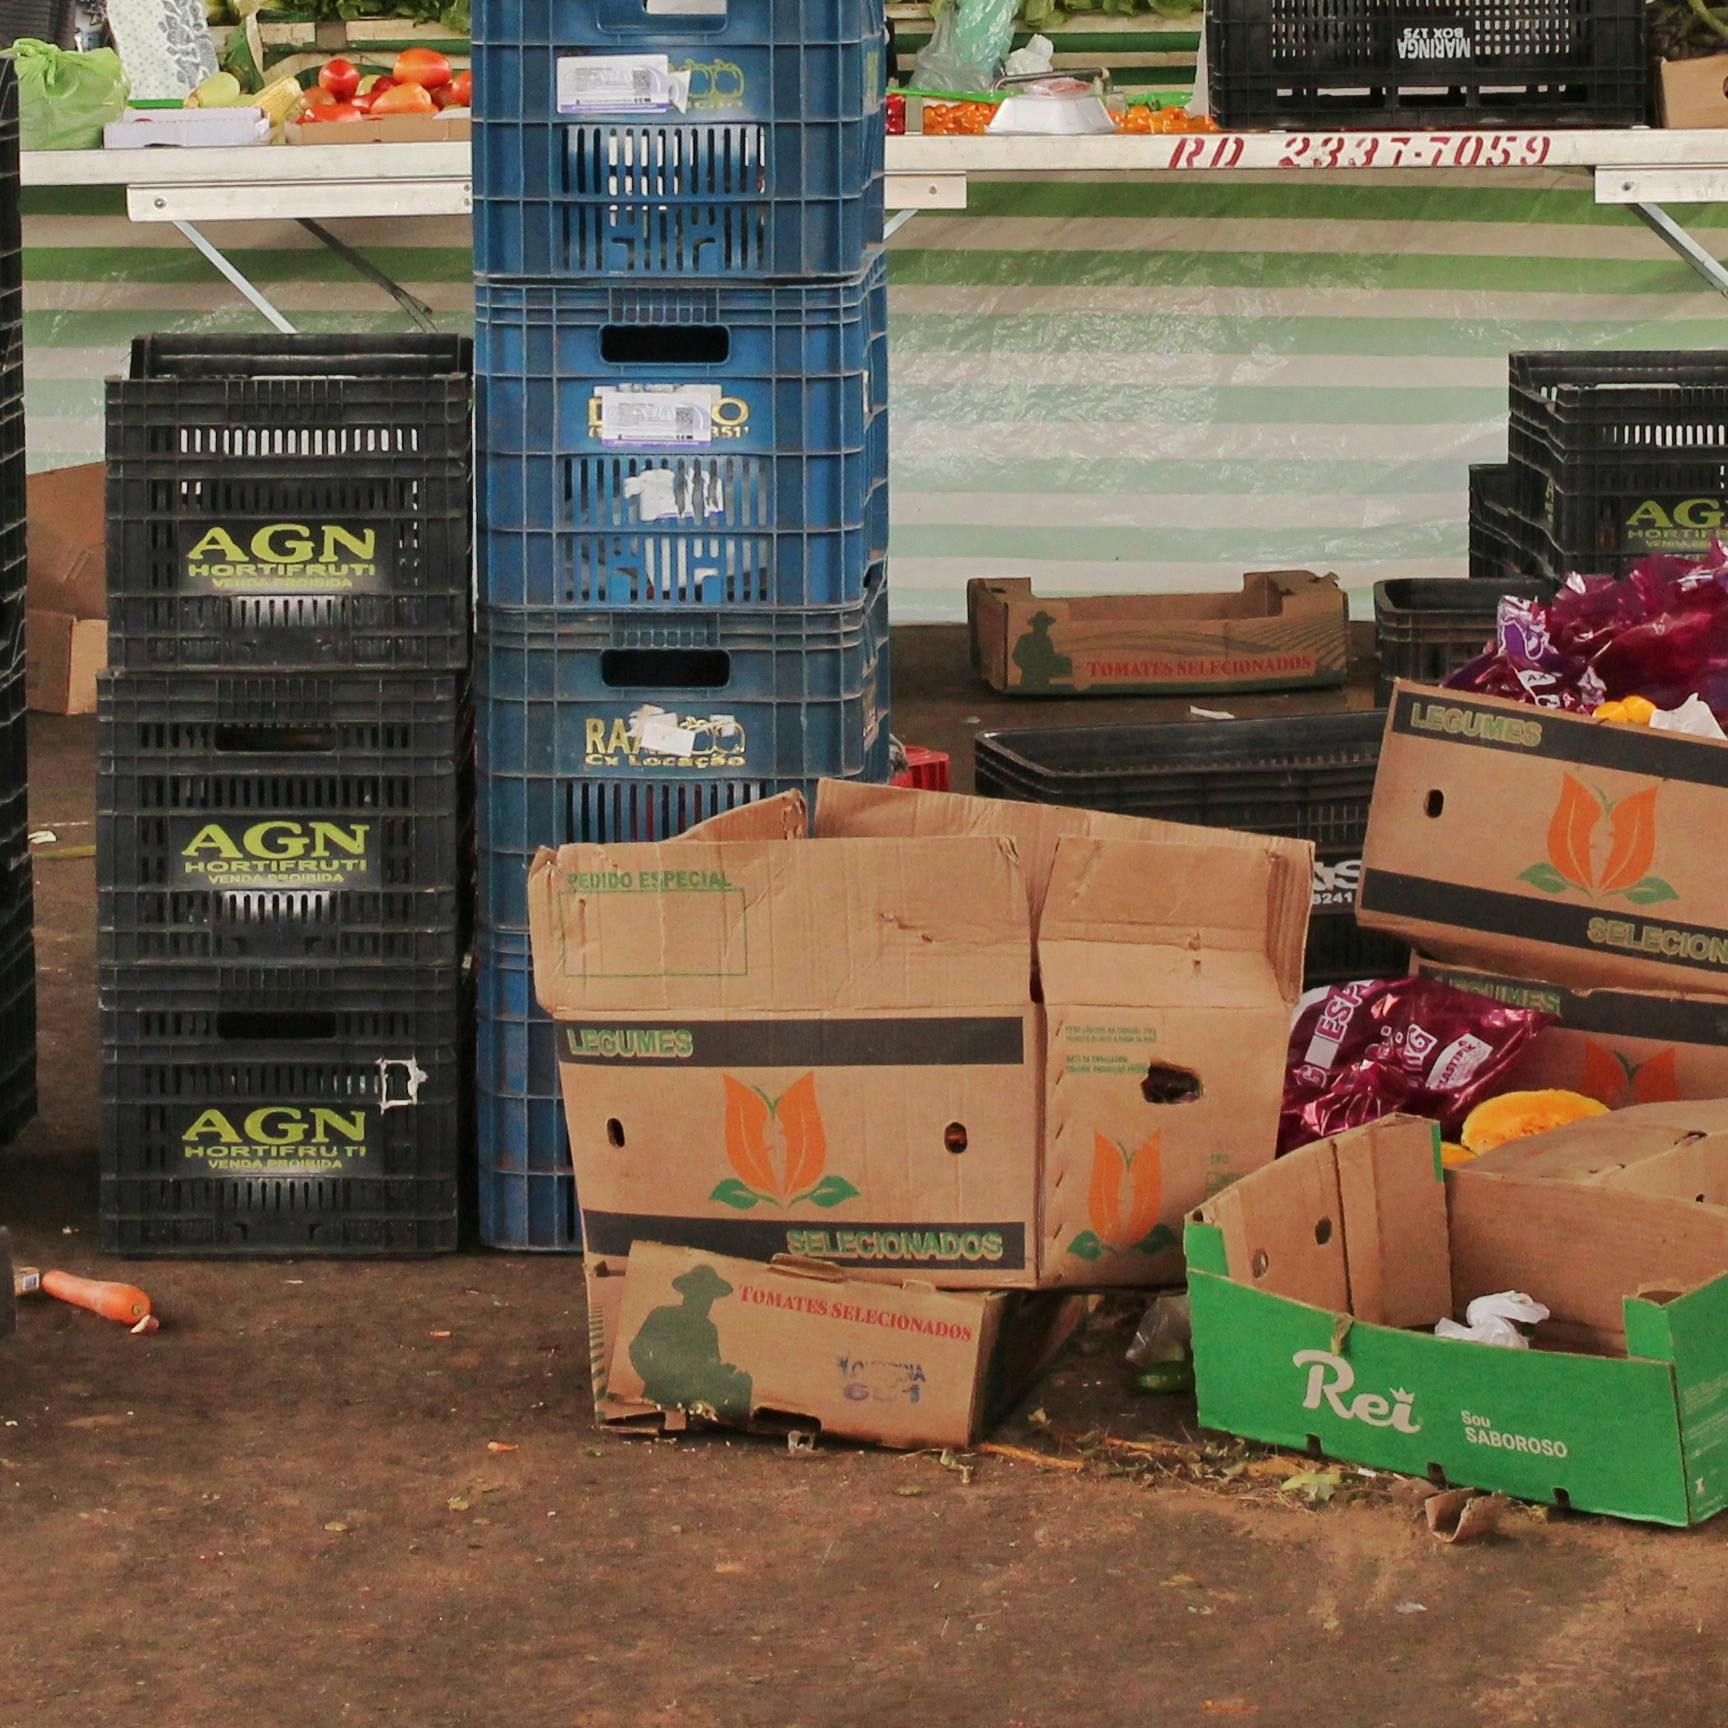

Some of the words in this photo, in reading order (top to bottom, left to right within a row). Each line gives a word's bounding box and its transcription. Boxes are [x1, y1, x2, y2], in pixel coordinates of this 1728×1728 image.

[186, 523, 376, 564] AGN
[188, 564, 377, 578] HORTIFRUTI
[1086, 660, 1174, 678] TOMATES
[1175, 654, 1313, 677] SELECIONADOS
[1410, 701, 1543, 748] LEGUMES
[181, 820, 371, 860] AGN
[184, 859, 369, 874] HORTIFRUTI
[565, 870, 634, 891] PEDIDO
[636, 869, 734, 891] ESPECIAL
[566, 1026, 694, 1059] LEGUMES
[181, 1106, 369, 1145] AGN
[786, 1227, 1004, 1263] SELECIONADOS
[738, 1282, 830, 1320] TOMATES
[831, 1299, 974, 1344] SELECIONADOS
[1291, 1348, 1422, 1436] Rei
[1459, 1407, 1492, 1428] Sou
[1464, 1424, 1569, 1459] SABOROSO
